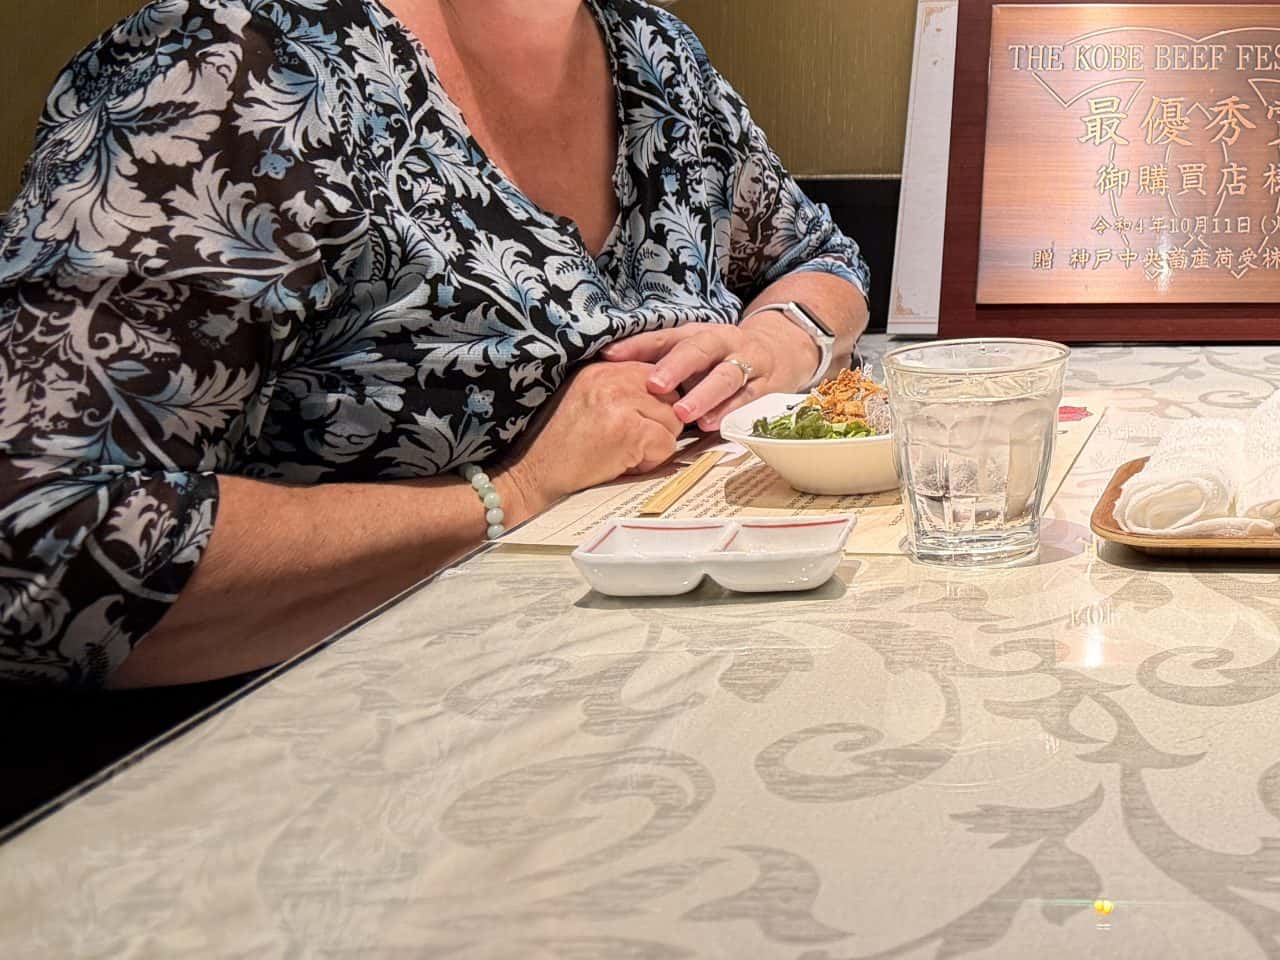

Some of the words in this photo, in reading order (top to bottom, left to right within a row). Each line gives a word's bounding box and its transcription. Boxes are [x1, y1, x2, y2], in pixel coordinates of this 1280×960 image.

[1009, 44, 1064, 71] THE
[1073, 44, 1145, 71] KOBE
[1154, 44, 1227, 71] BEEF
